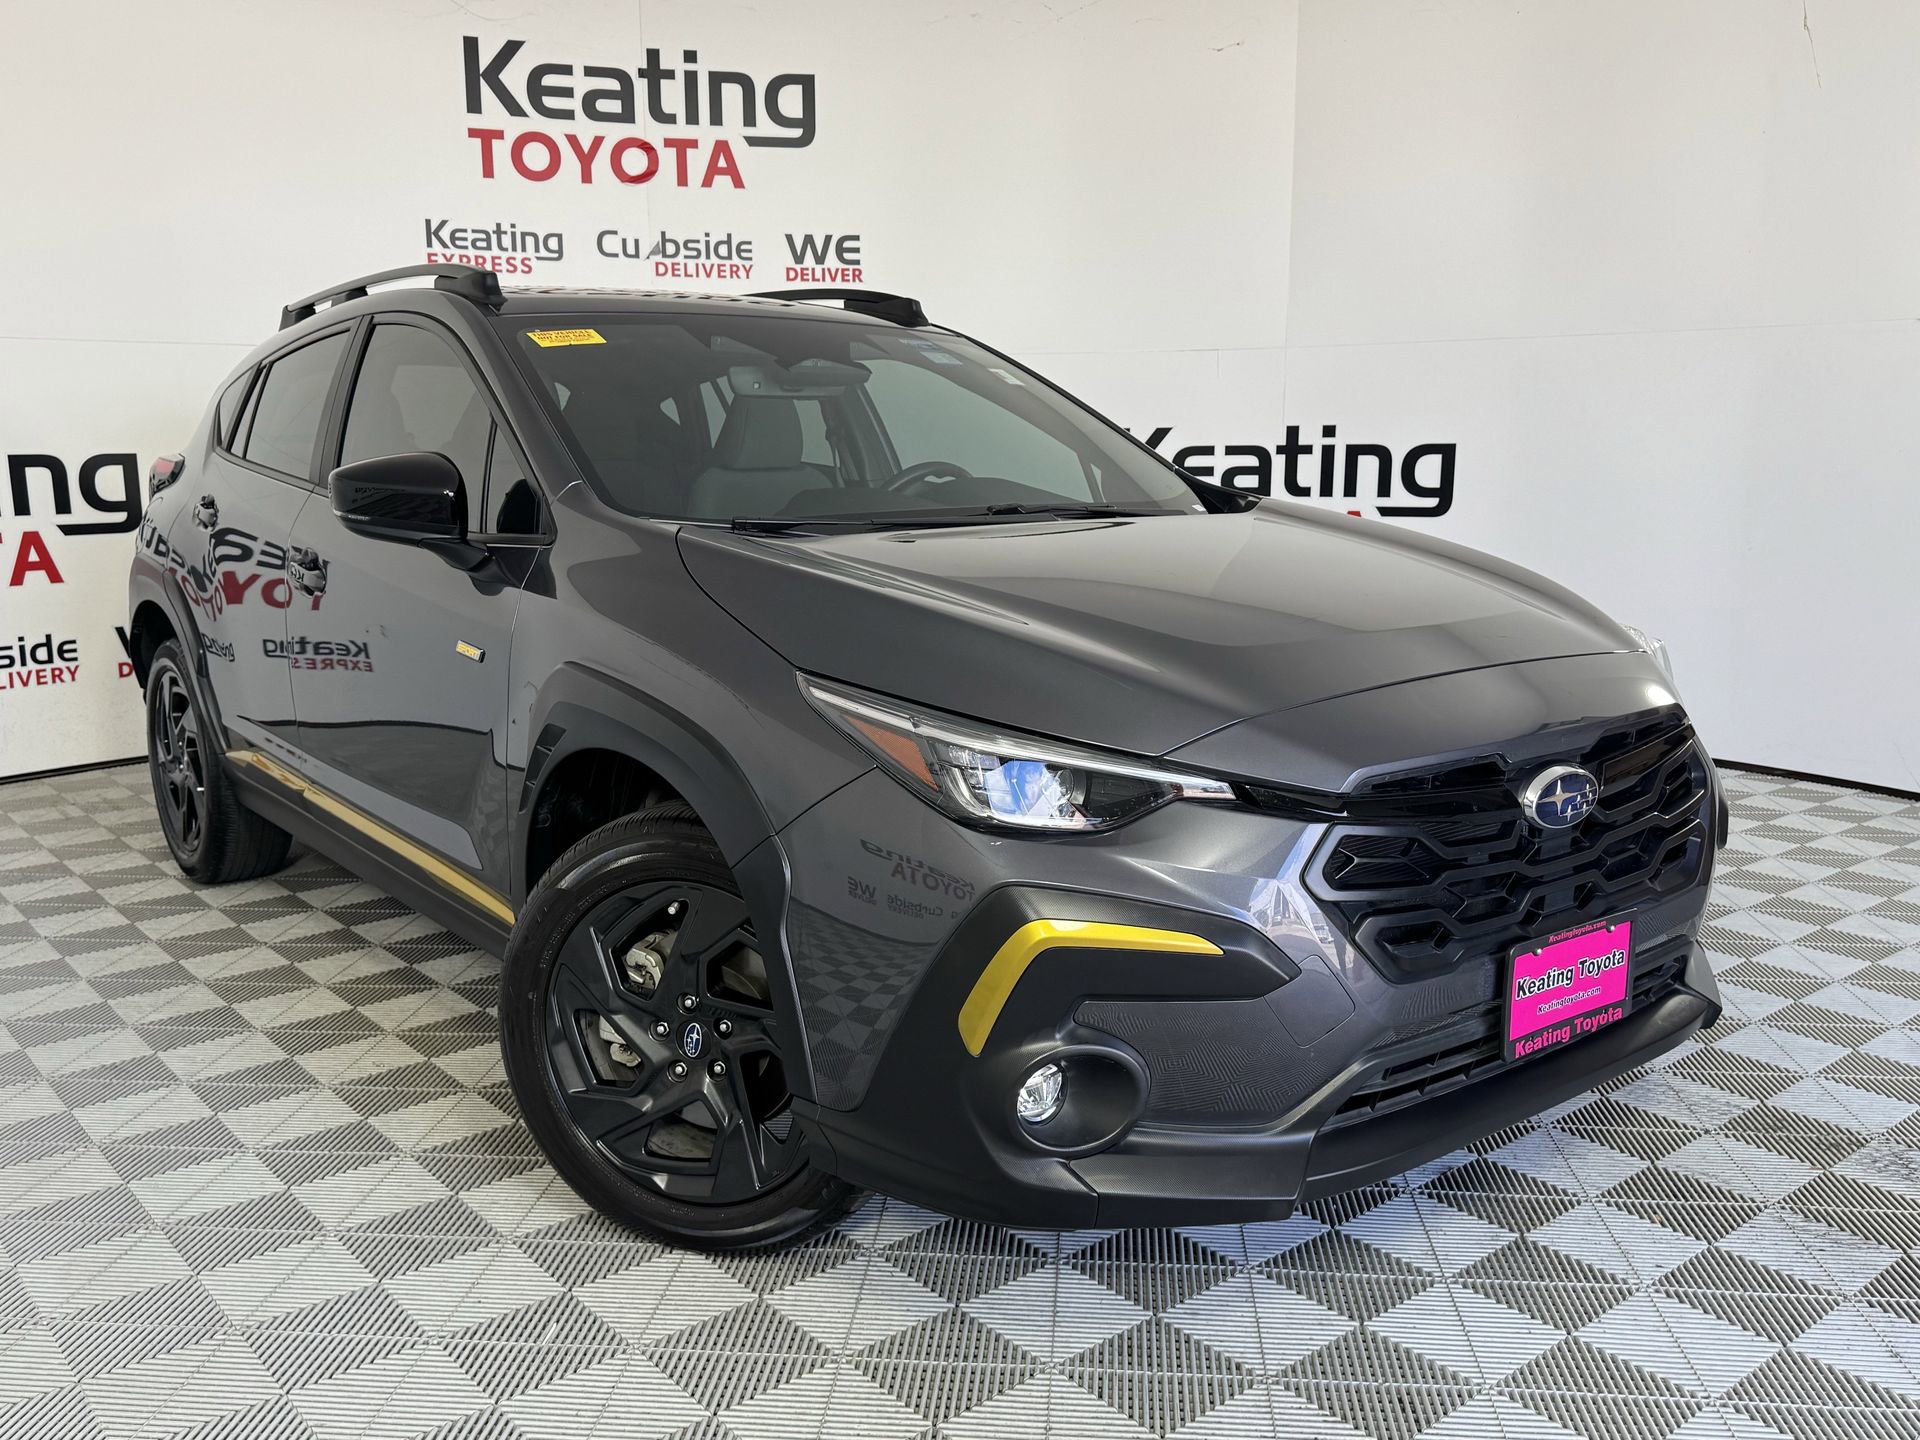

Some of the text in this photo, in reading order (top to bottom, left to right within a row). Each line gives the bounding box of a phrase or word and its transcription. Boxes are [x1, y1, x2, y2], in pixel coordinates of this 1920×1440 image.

[463, 35, 816, 148] Keating
[467, 127, 745, 189] TOYOTA
[425, 218, 564, 261] Keating
[655, 262, 753, 279] DELIVERY
[785, 267, 864, 283] DELIVER
[1515, 949, 1625, 1000] Keating Toyota
[1537, 986, 1601, 1014] Keatingtoyota.com
[1514, 1007, 1623, 1058] Keating Toyota
